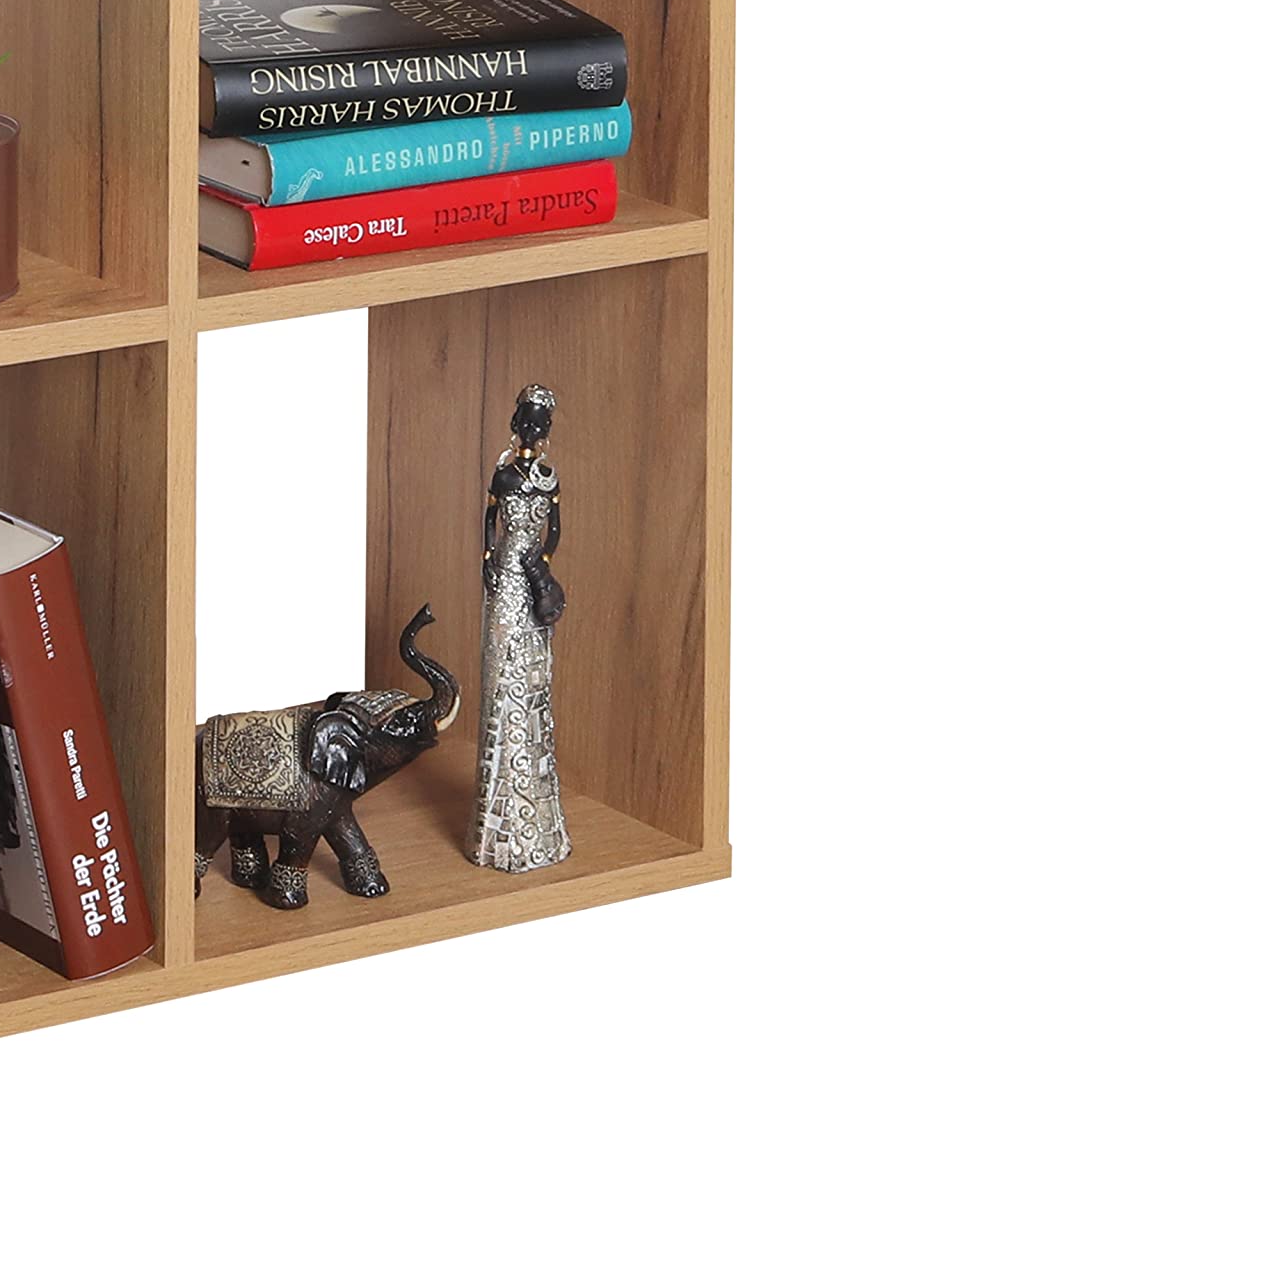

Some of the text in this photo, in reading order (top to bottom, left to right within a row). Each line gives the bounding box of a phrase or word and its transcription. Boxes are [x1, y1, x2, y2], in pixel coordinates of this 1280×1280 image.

[205, 0, 321, 56] HARRIS
[250, 49, 528, 95] HANNIBAL RISING
[258, 90, 518, 131] THOMAS HARRIS
[345, 120, 619, 177] ALESSANDRO PIPERNO
[303, 216, 408, 245] Tara Calese
[433, 188, 600, 234] Sandra Paretti
[29, 573, 57, 661] KARL MÜLLER
[62, 729, 88, 801] Sandra Paretti
[72, 854, 108, 938] der Erde
[91, 811, 128, 925] Die Pächter
